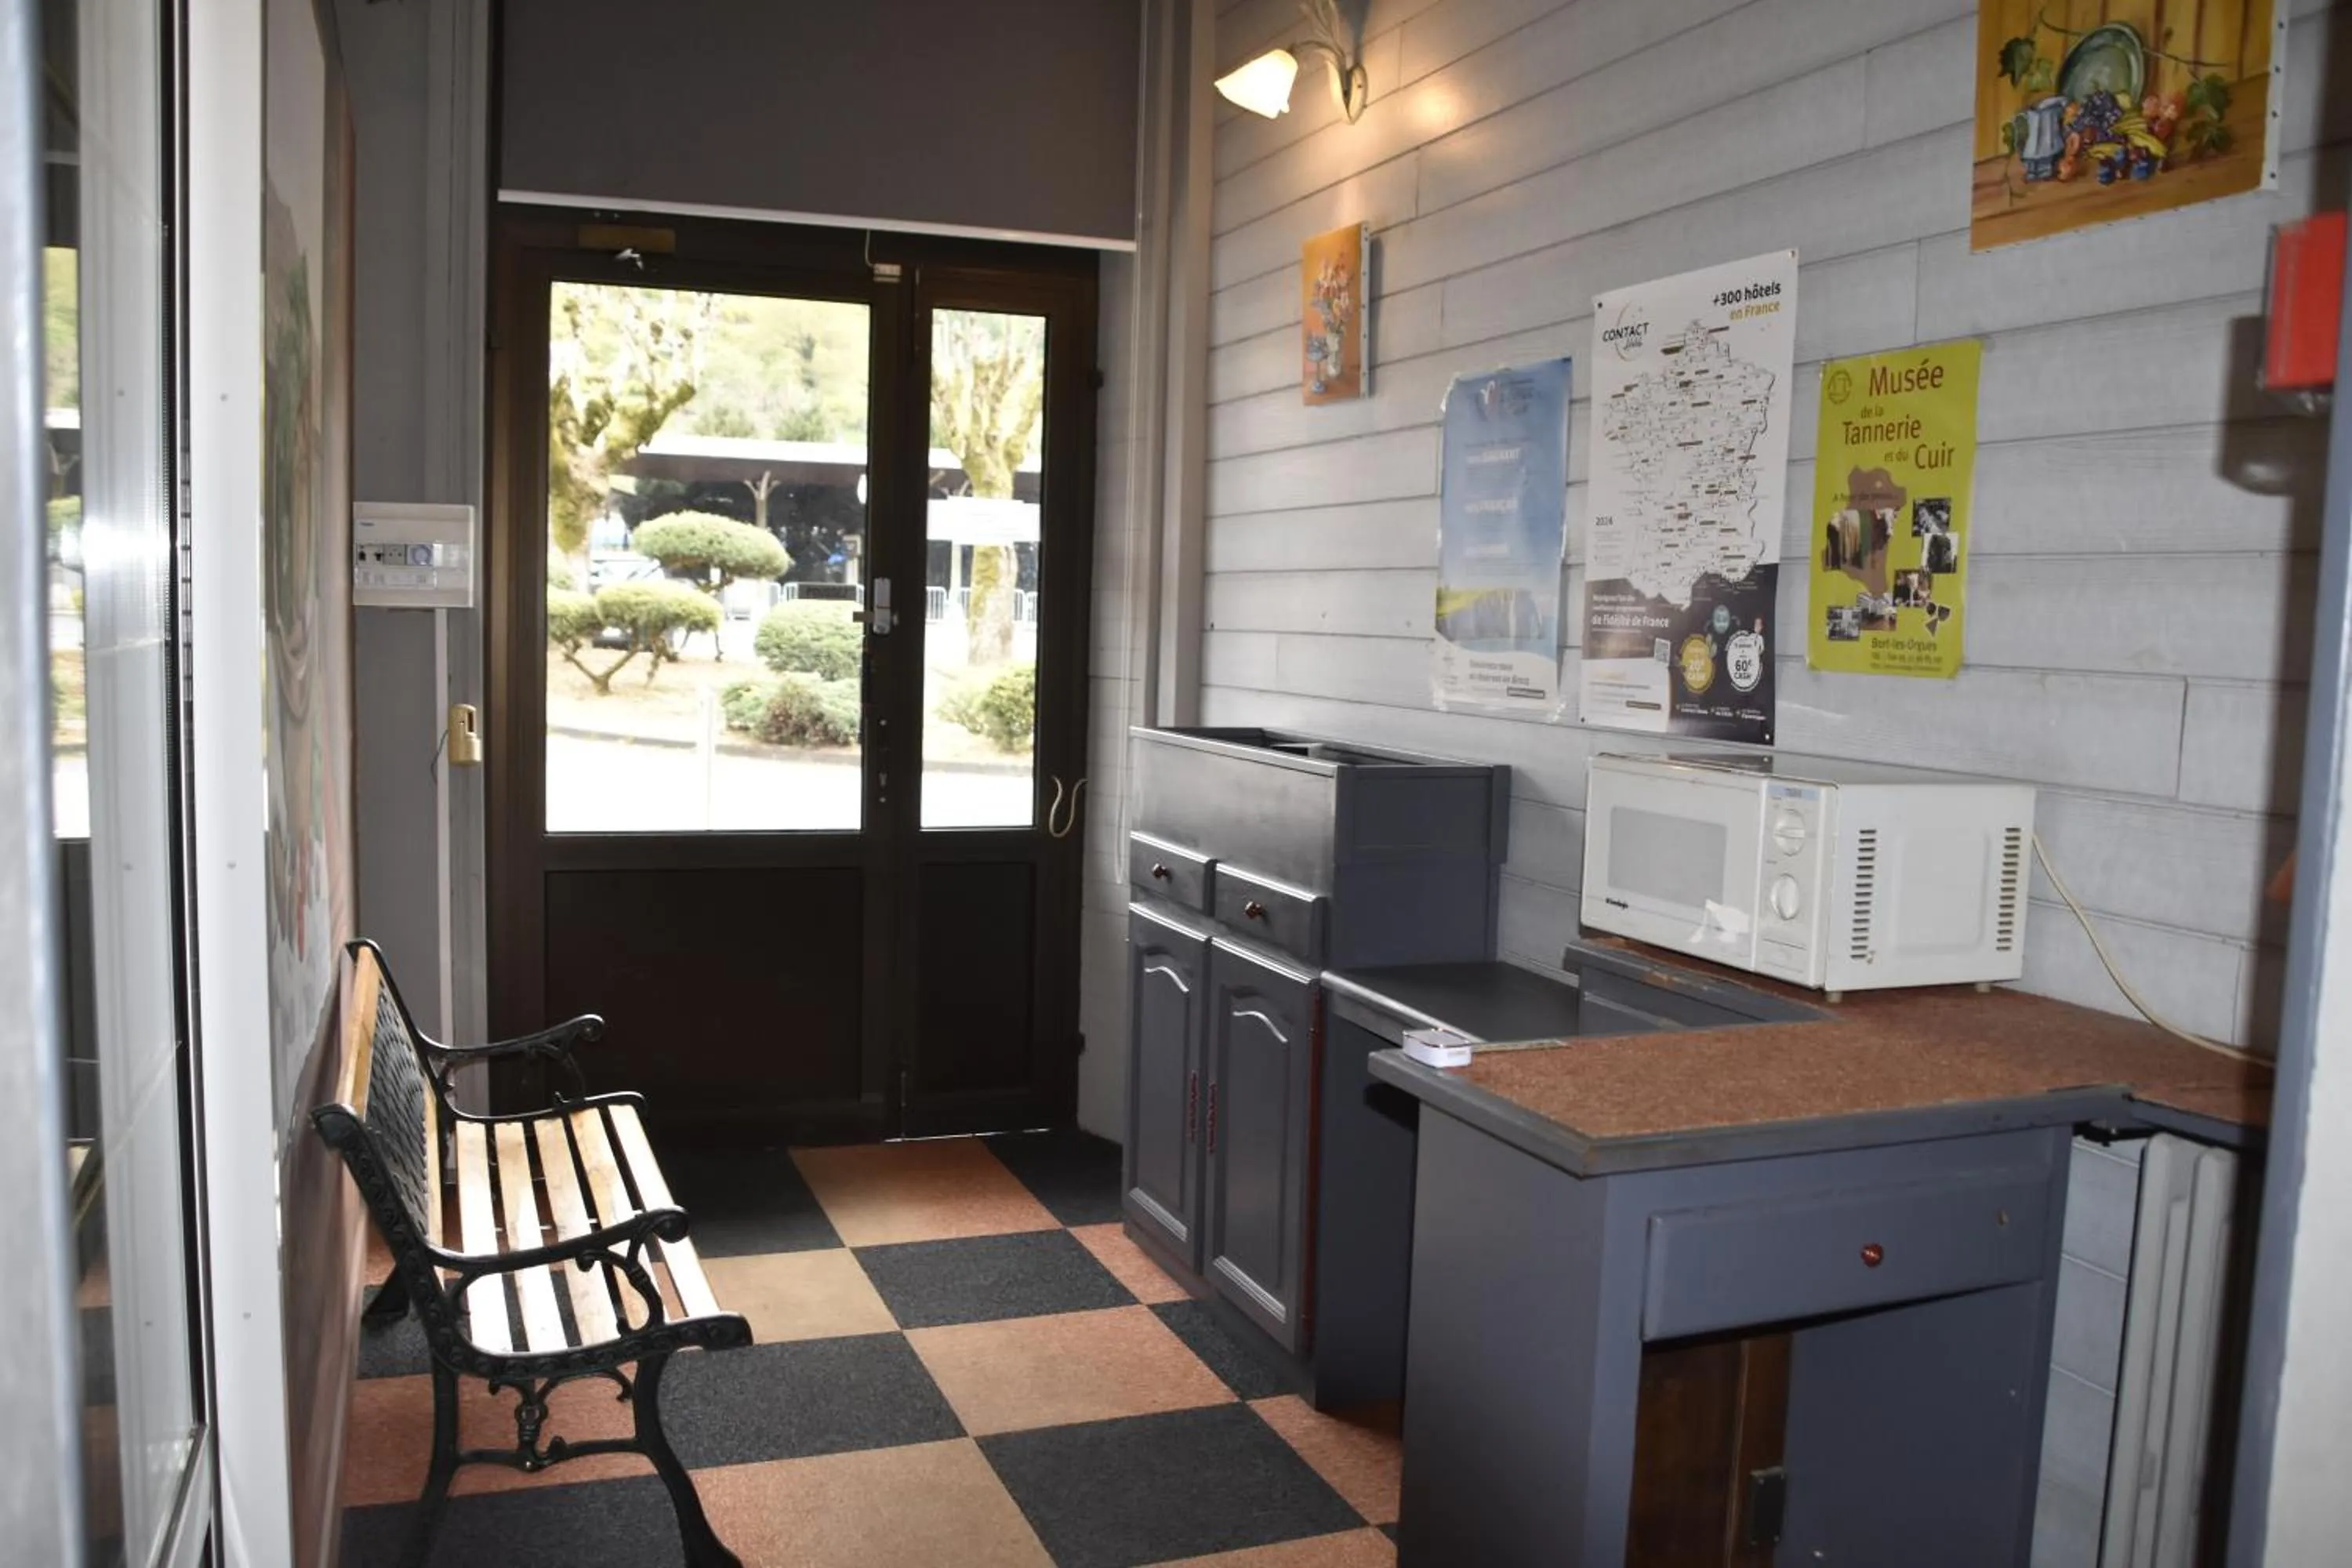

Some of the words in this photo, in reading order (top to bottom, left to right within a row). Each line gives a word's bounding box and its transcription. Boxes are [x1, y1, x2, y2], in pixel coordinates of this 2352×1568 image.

[1713, 288, 1741, 307] +300
[1744, 281, 1781, 300] hôtels
[1744, 301, 1780, 318] France
[1602, 321, 1650, 343] CONTACT
[1869, 358, 1944, 397] Musée
[1860, 406, 1873, 419] de
[1842, 414, 1922, 446] Tannerie
[1915, 441, 1957, 470] Cuir
